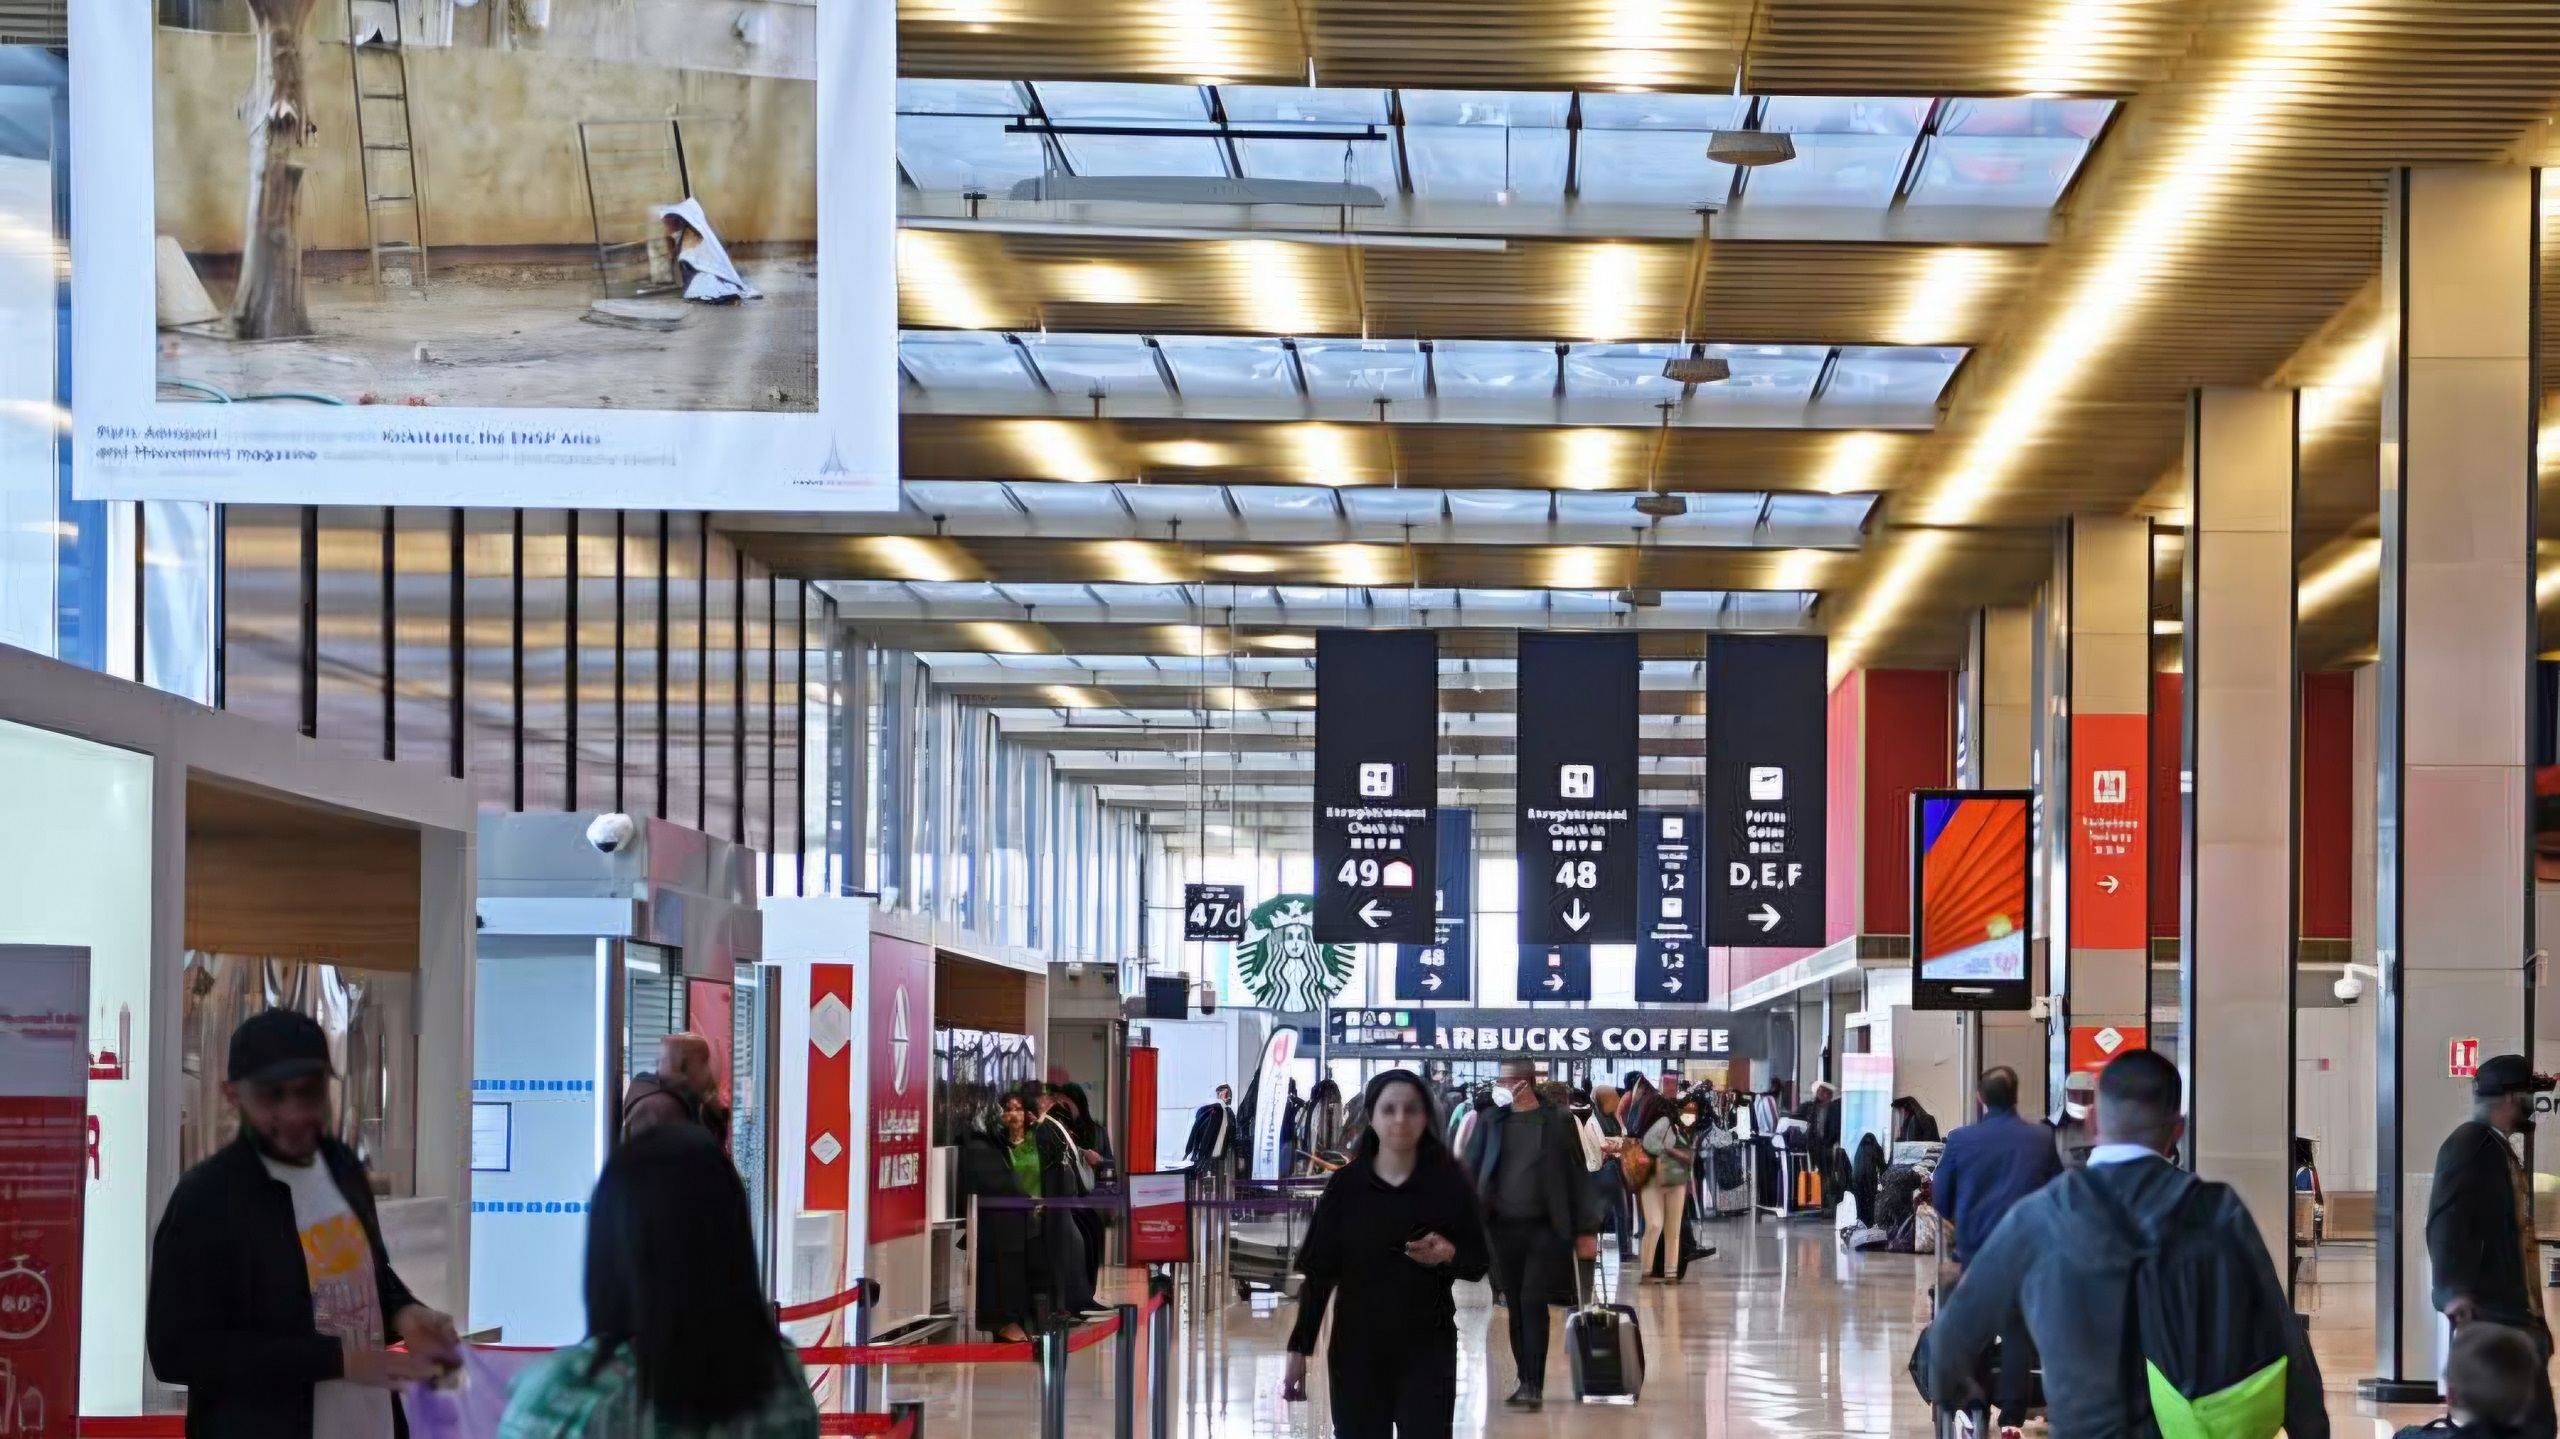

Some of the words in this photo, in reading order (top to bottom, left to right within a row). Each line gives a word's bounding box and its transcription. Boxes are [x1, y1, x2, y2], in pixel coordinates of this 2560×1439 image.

[1338, 859, 1379, 887] 49
[1556, 861, 1597, 889] 48
[1729, 862, 1803, 890] D,E,F
[1189, 902, 1241, 928] 47d
[1602, 1026, 1730, 1052] COFFEE
